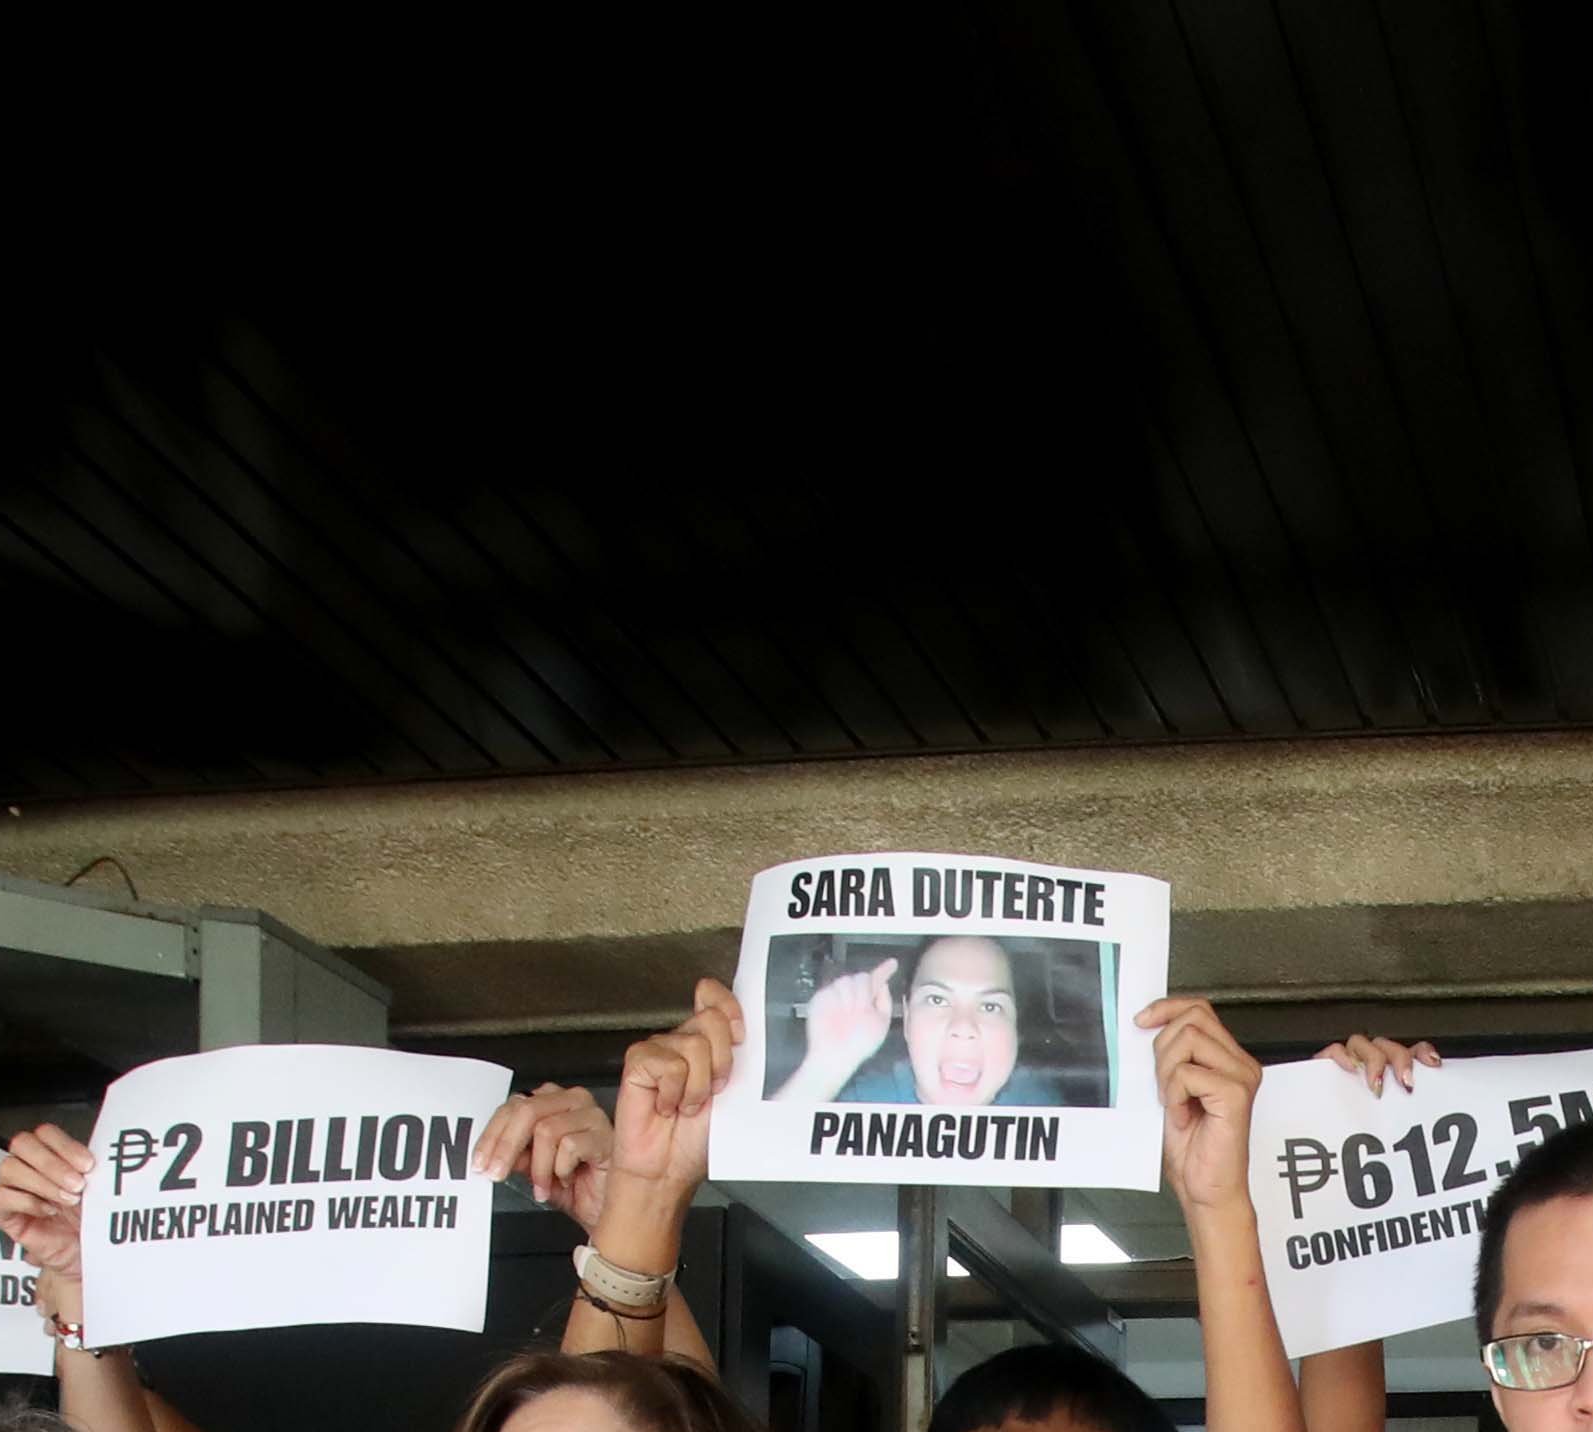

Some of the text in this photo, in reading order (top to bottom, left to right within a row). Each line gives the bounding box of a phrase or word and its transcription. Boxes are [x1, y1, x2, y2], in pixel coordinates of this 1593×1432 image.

[787, 867, 1105, 926] SARA DUTERTE
[108, 1114, 475, 1196] ₱2 BILLION
[810, 1111, 1060, 1161] PANAGUTIN
[109, 1195, 459, 1245] UNEXPLAINED WEALTH
[1286, 1198, 1488, 1271] CONFIDENTI
